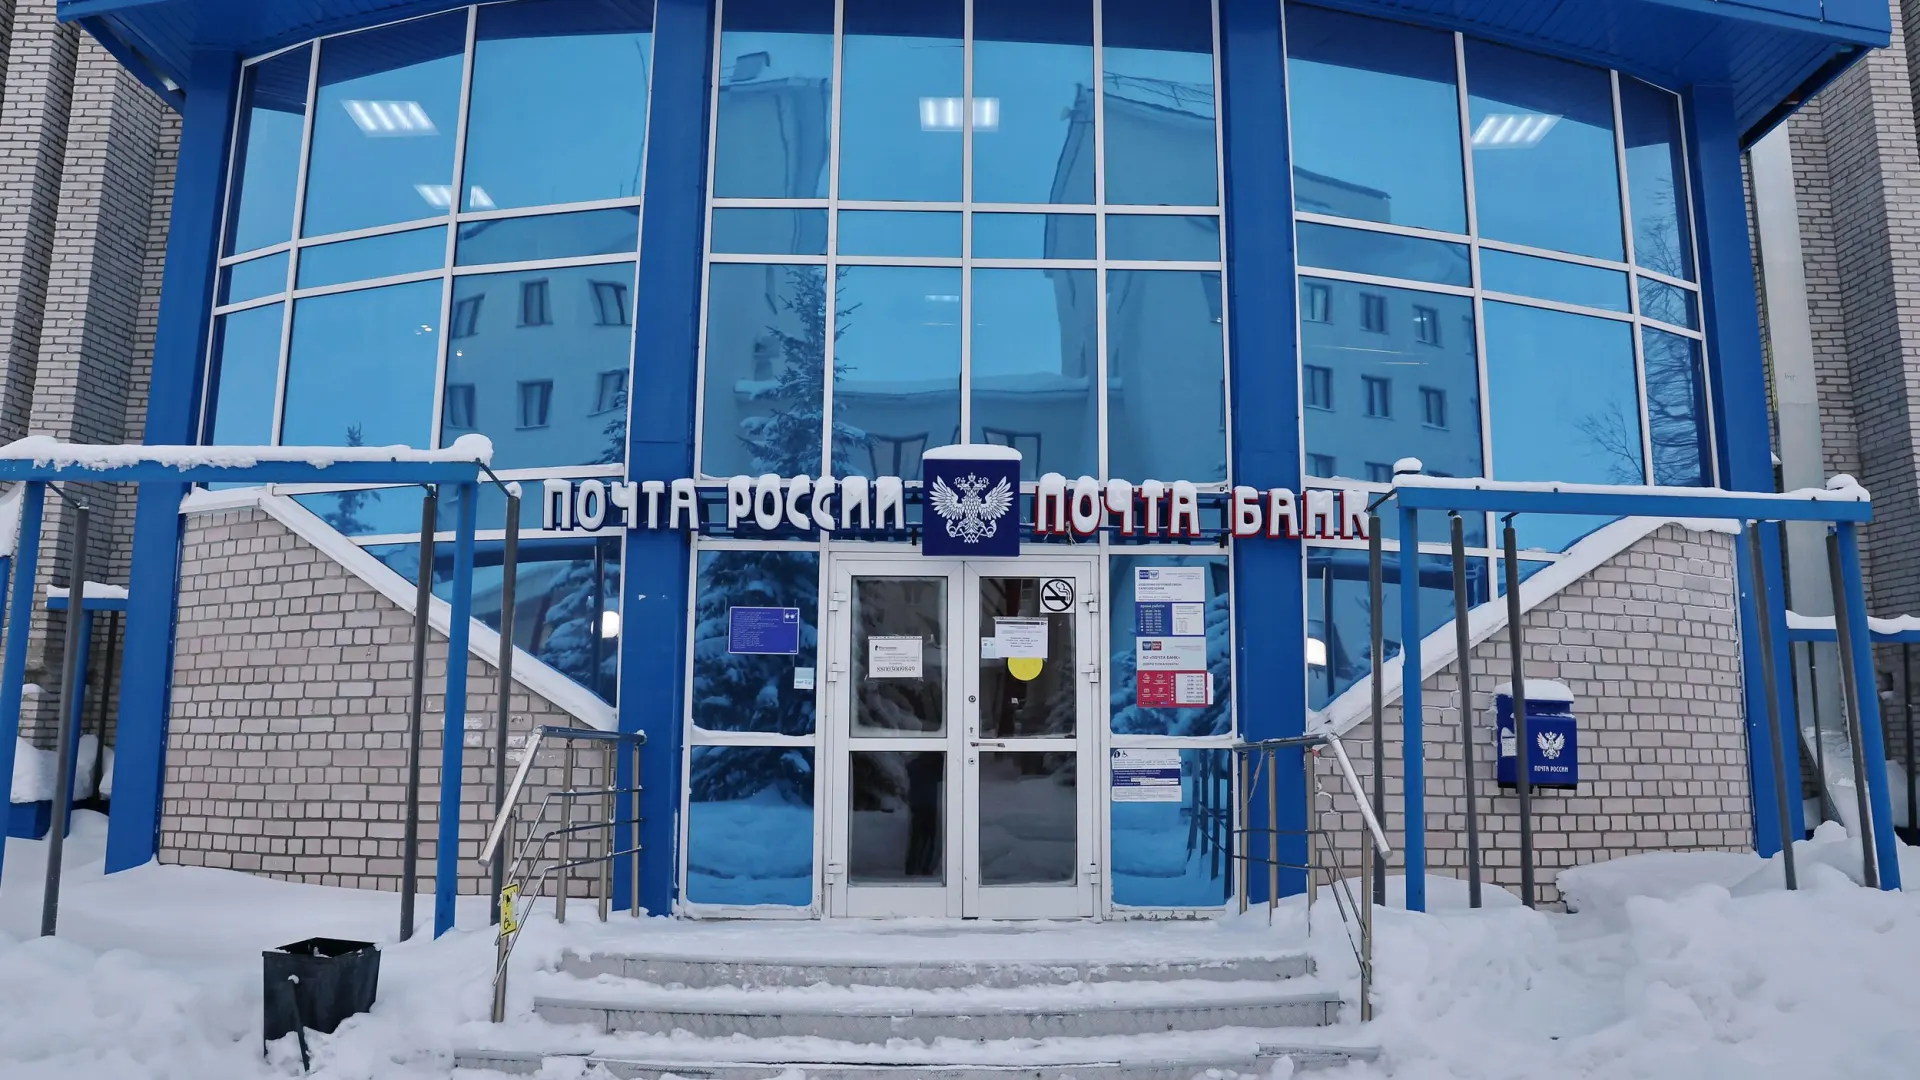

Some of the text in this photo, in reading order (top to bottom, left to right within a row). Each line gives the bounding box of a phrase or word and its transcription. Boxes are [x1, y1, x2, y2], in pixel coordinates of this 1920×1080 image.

[542, 475, 905, 532] ПОЧТА РОССИИ
[1034, 477, 1370, 540] ПОЧТА БАНК
[1550, 765, 1569, 773] РОССИИ
